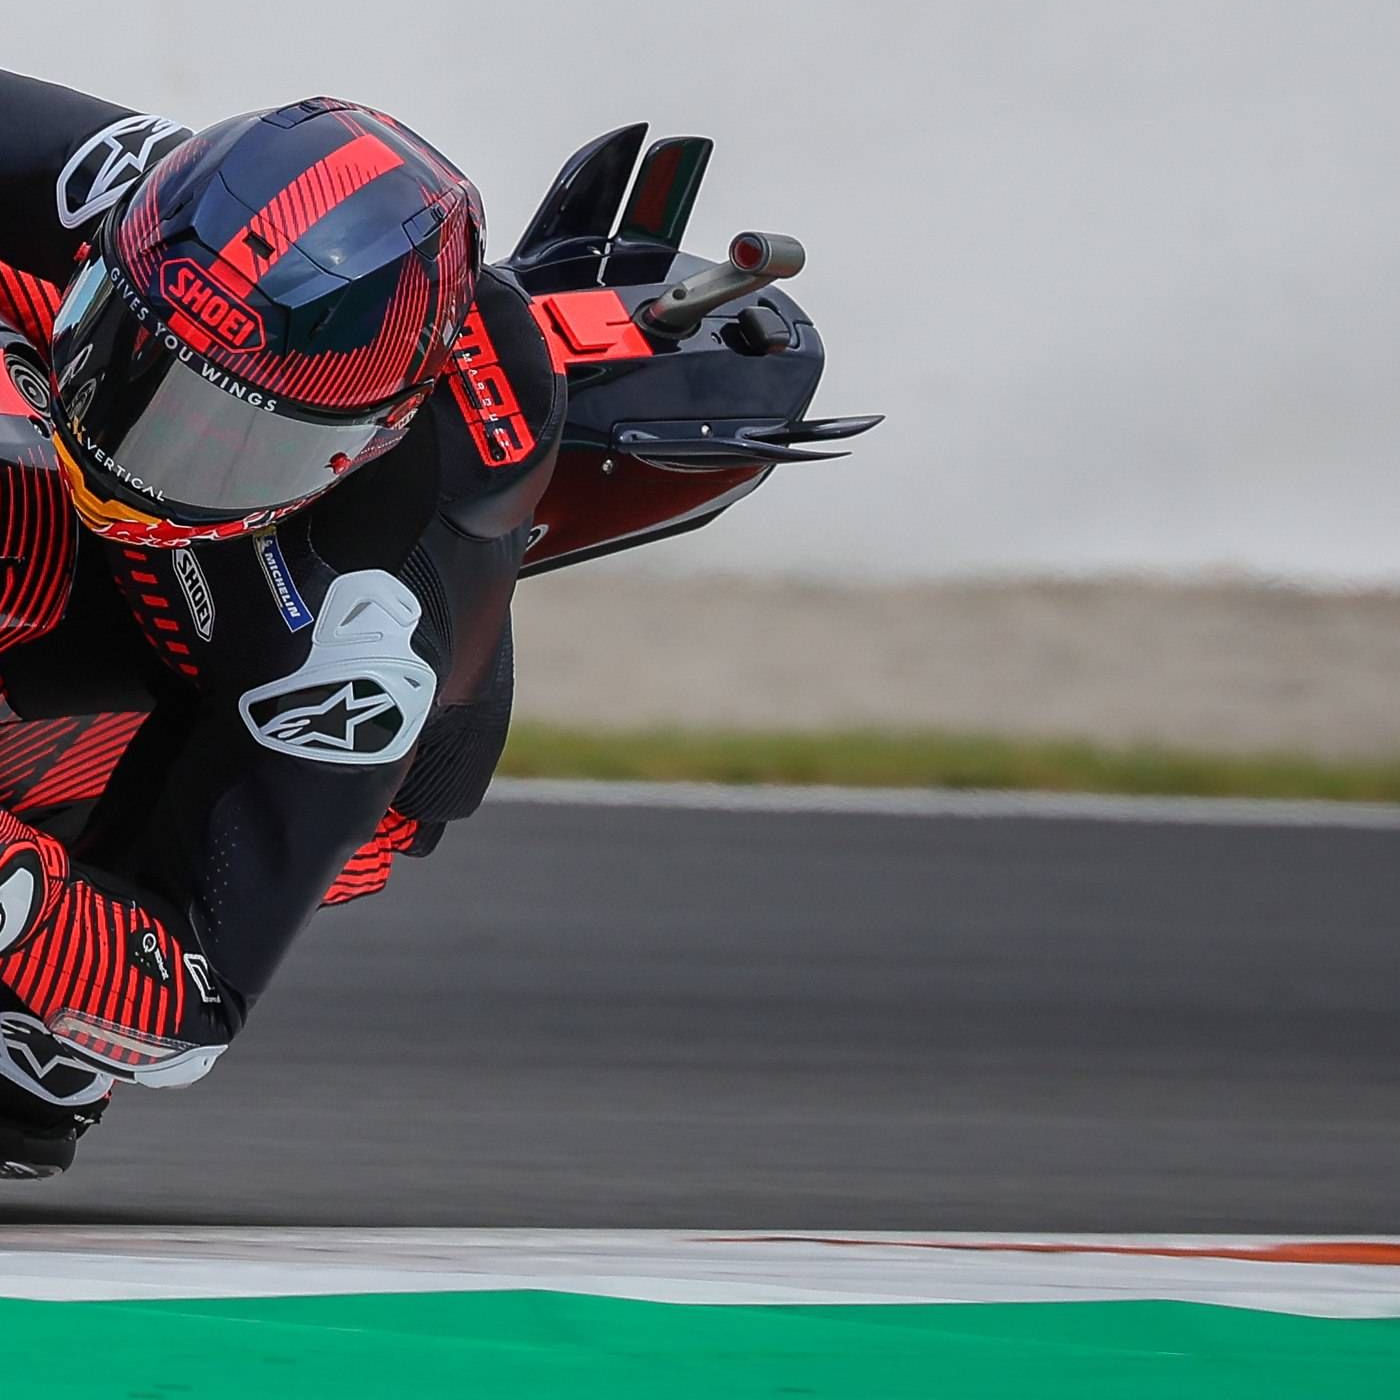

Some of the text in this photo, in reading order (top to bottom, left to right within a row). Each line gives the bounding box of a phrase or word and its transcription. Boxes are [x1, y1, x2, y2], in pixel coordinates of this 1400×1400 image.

[110, 267, 278, 413] GIVES YOU WINGS
[168, 267, 256, 346] SHOEI
[177, 551, 211, 630] SHOEI
[264, 551, 301, 619] MICHELIN
